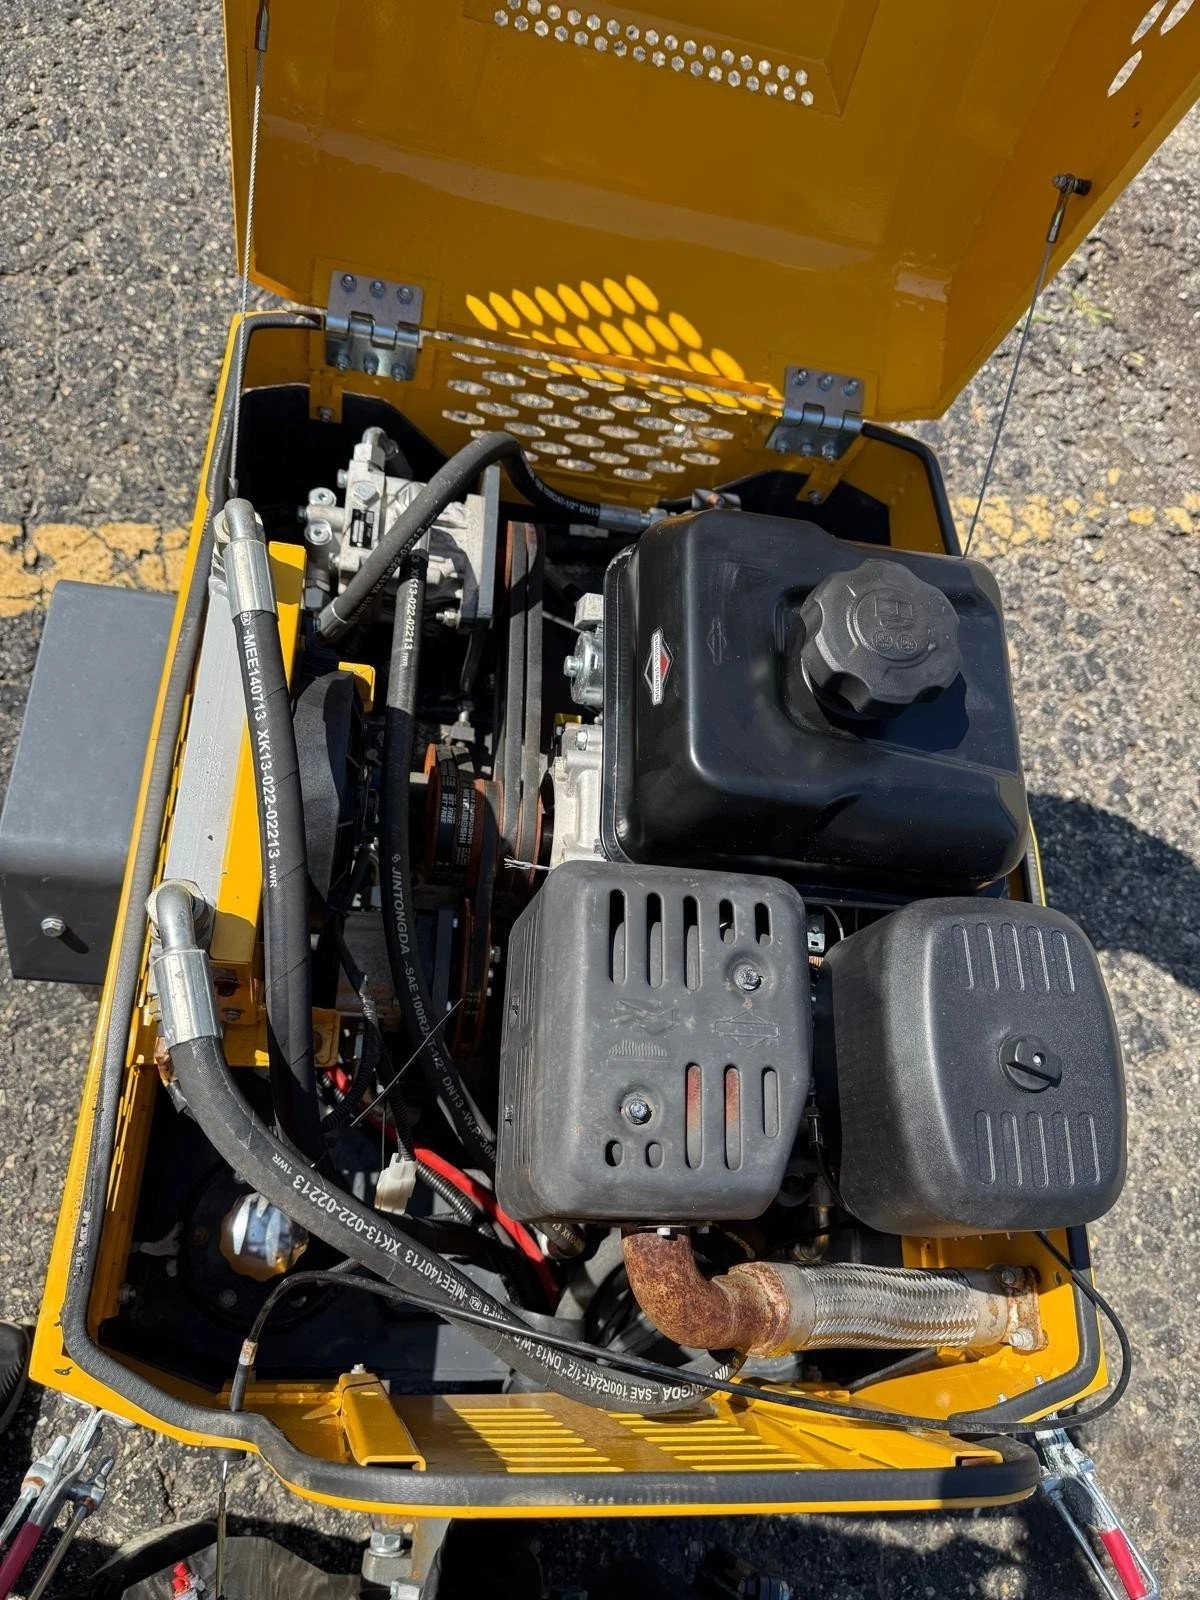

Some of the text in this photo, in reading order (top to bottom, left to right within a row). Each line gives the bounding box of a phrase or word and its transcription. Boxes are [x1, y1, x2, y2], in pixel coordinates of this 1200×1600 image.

[243, 629, 267, 722] -MEE140713
[257, 729, 280, 859] XK13-022-02213
[268, 864, 278, 888] 1WR
[391, 866, 410, 955] JINTONGDA
[441, 1075, 465, 1109] DN13
[271, 1153, 293, 1175] 1WR
[292, 1174, 402, 1256] XK13-022-02213
[404, 1249, 469, 1301] -MEE140713
[535, 1344, 562, 1370] DN13
